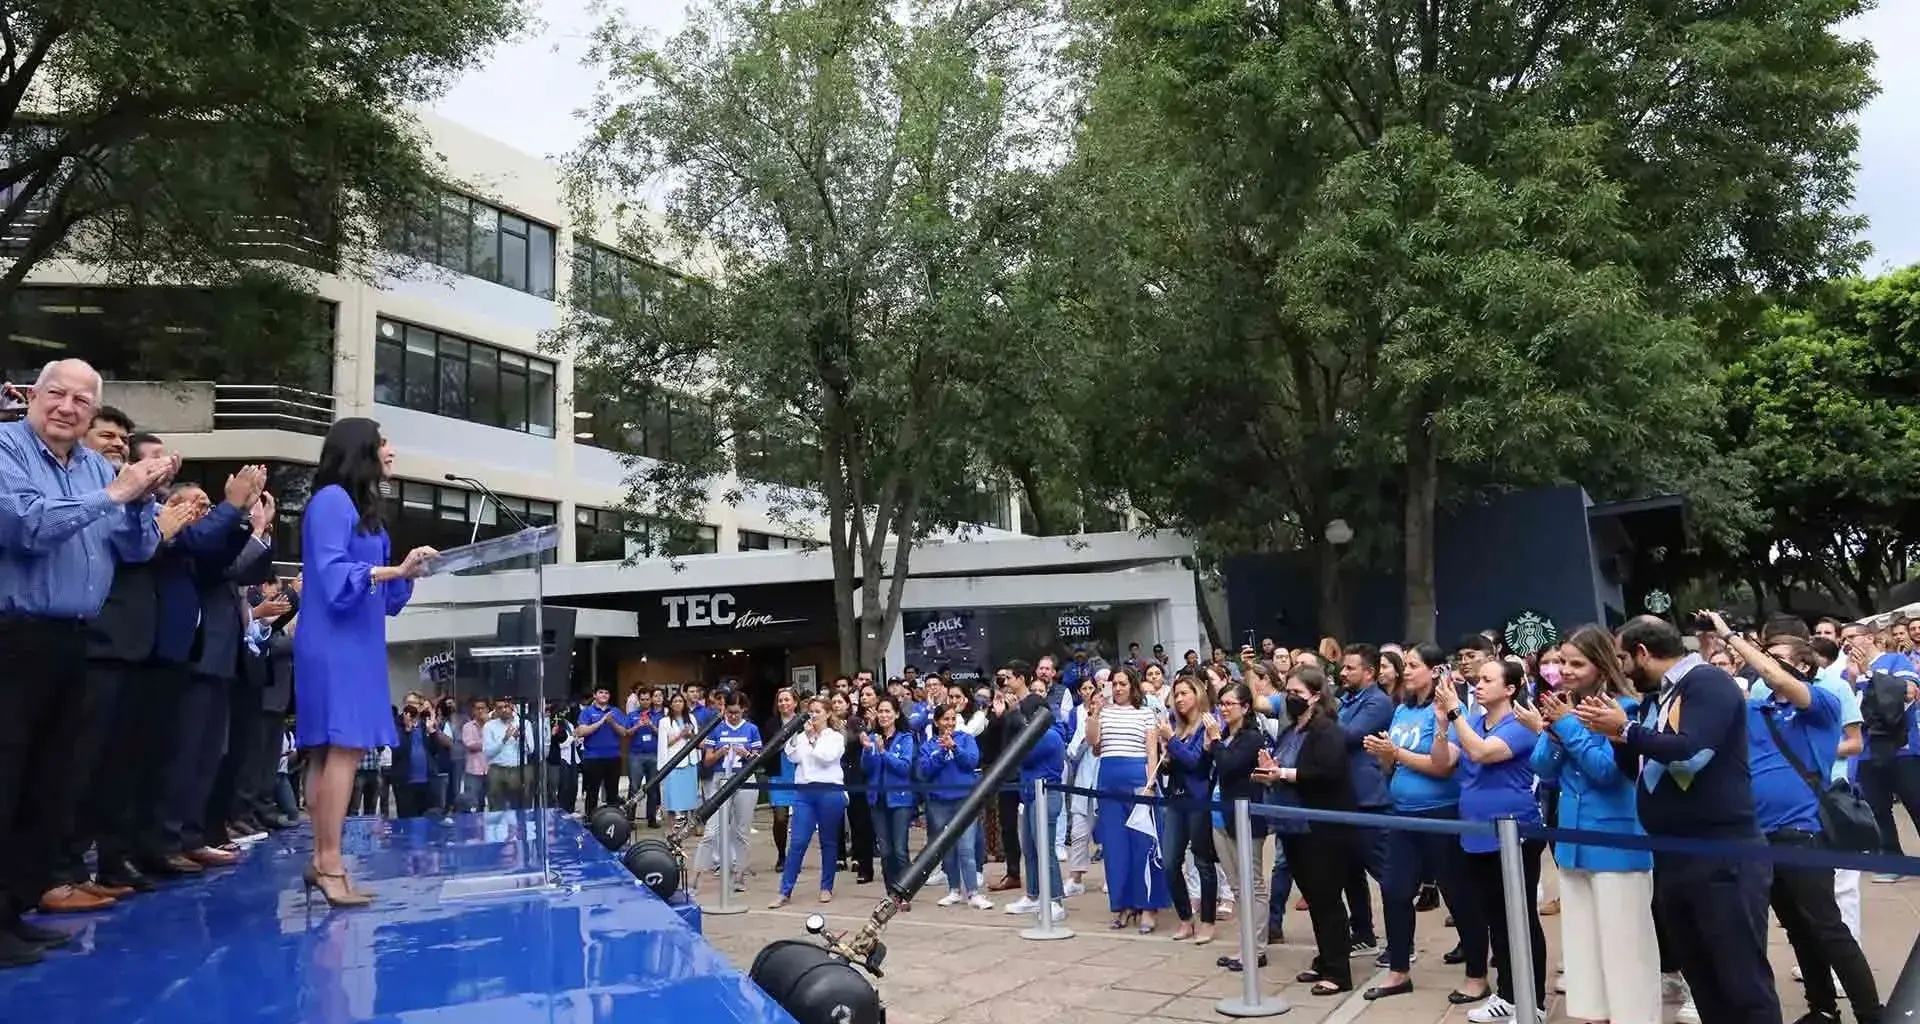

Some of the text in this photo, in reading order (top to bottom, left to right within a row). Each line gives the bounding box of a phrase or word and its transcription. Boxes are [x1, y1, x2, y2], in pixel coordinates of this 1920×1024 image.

[661, 593, 809, 629] TEC store
[927, 617, 963, 633] BACK
[1058, 615, 1090, 626] PRESS
[1059, 626, 1090, 637] START
[424, 651, 455, 666] BACK
[951, 672, 980, 680] COMPRA
[606, 823, 616, 839] 4
